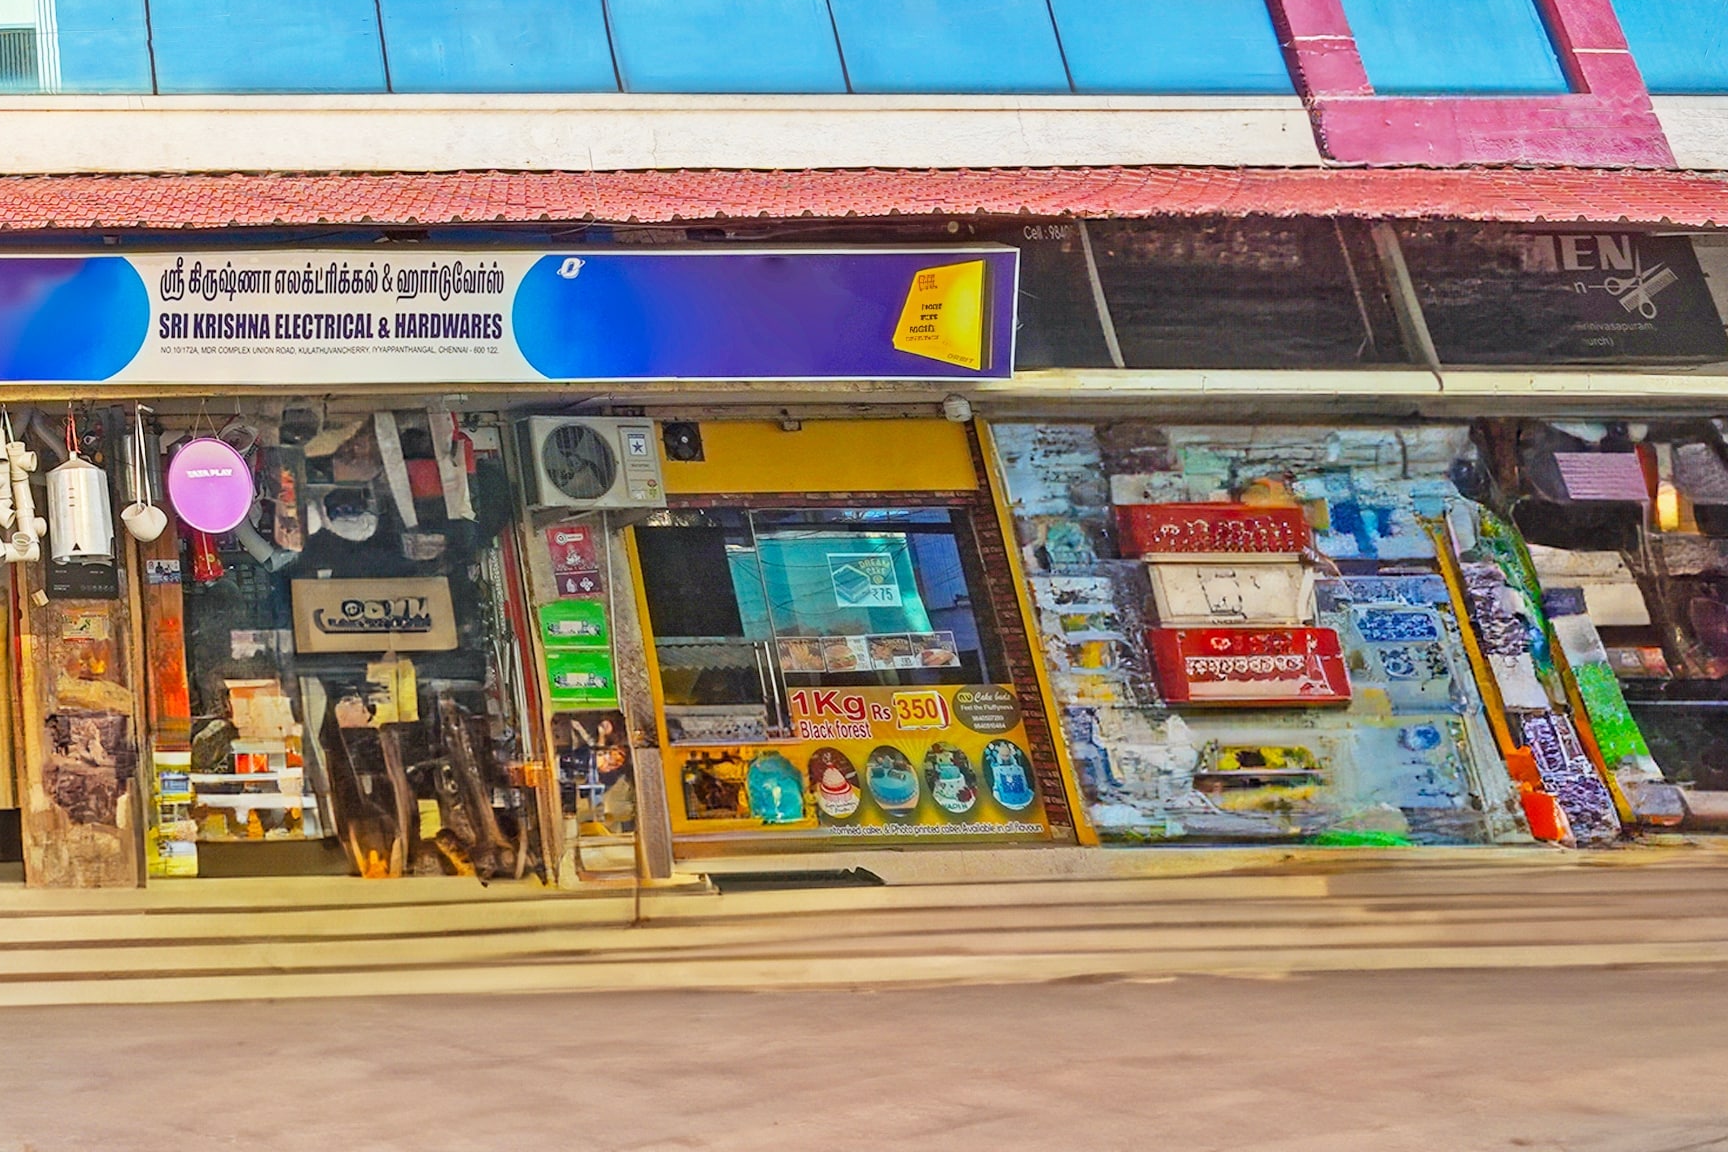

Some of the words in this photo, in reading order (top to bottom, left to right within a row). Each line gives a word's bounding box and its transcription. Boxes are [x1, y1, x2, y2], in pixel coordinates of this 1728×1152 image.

[1023, 225, 1042, 240] Cell
[188, 261, 272, 302] கிருஷ்ணா
[274, 261, 378, 295] எலக்ட்ரிக்கல்
[382, 263, 393, 293] &
[159, 312, 189, 339] SRI
[193, 312, 270, 339] KRISHNA
[274, 313, 374, 339] ELECTRICAL
[378, 317, 390, 339] &
[394, 313, 503, 339] HARDWARES
[201, 346, 217, 354] MDR
[218, 346, 251, 354] COMPLEX
[252, 346, 274, 354] UNION
[438, 345, 469, 354] CHENNAI
[947, 352, 975, 364] ORBIT
[186, 469, 211, 478] TATA
[211, 468, 232, 477] PLAY
[792, 689, 867, 721] 1Kg
[872, 703, 891, 722] Rs
[896, 698, 939, 720] 350
[800, 719, 833, 739] Black
[835, 720, 872, 739] forest
